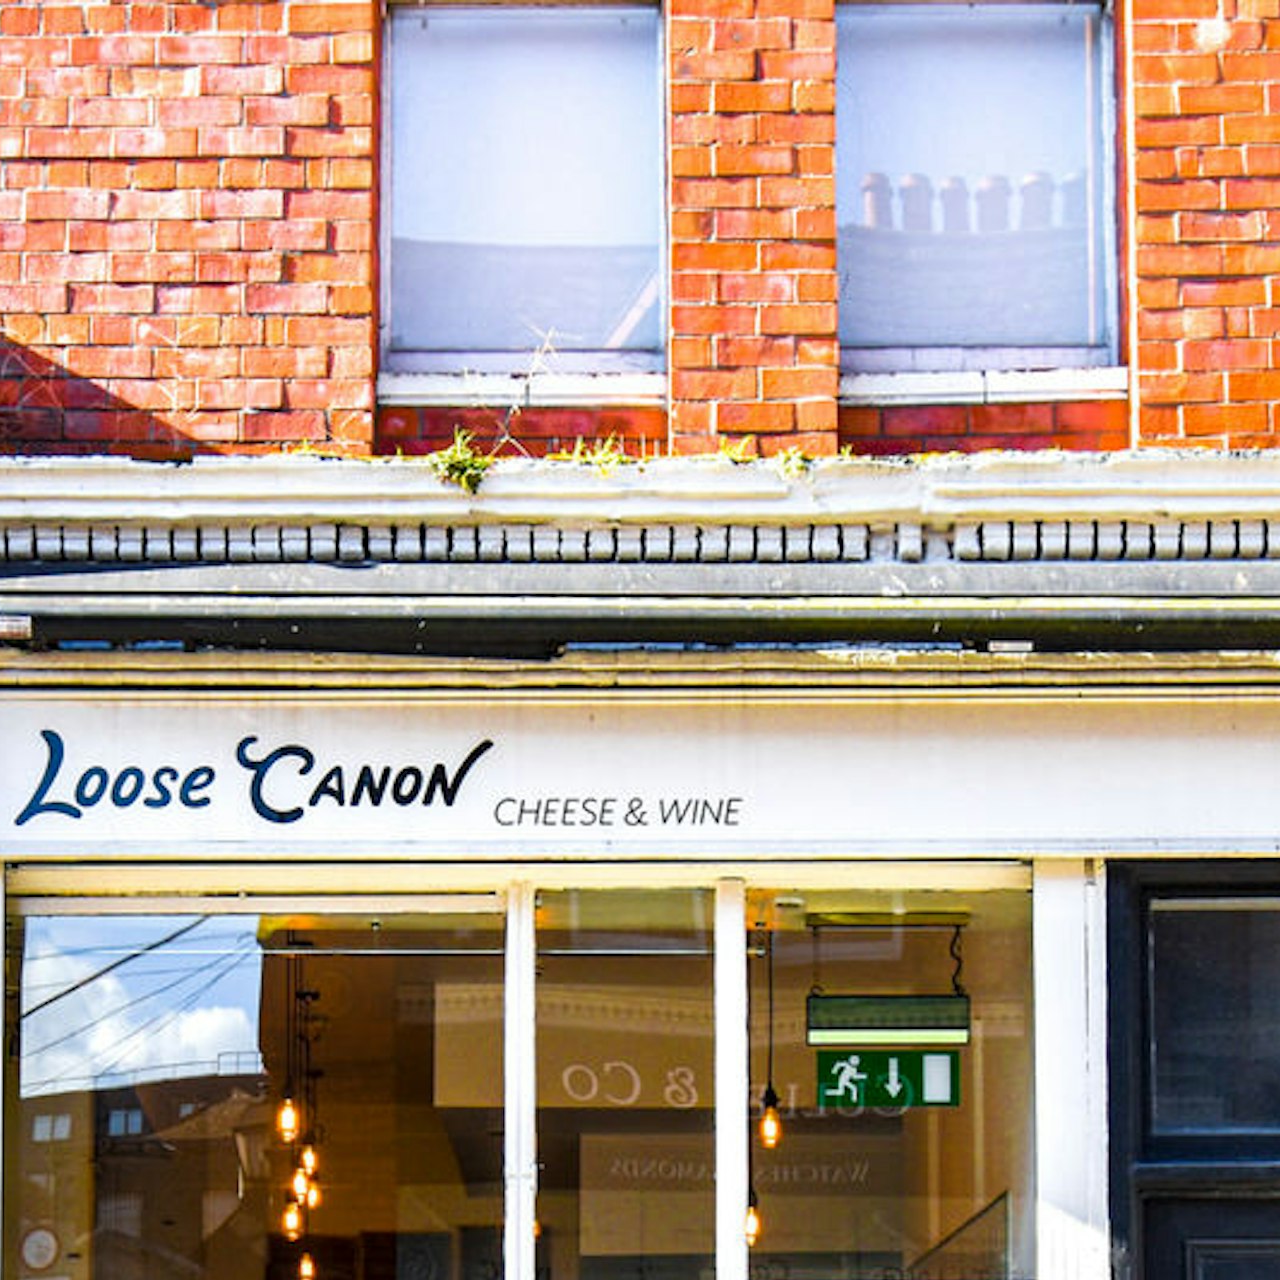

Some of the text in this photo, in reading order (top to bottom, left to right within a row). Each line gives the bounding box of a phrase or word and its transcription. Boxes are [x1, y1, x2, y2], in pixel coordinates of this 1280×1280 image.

[494, 797, 743, 827] CHEESE & WINE
